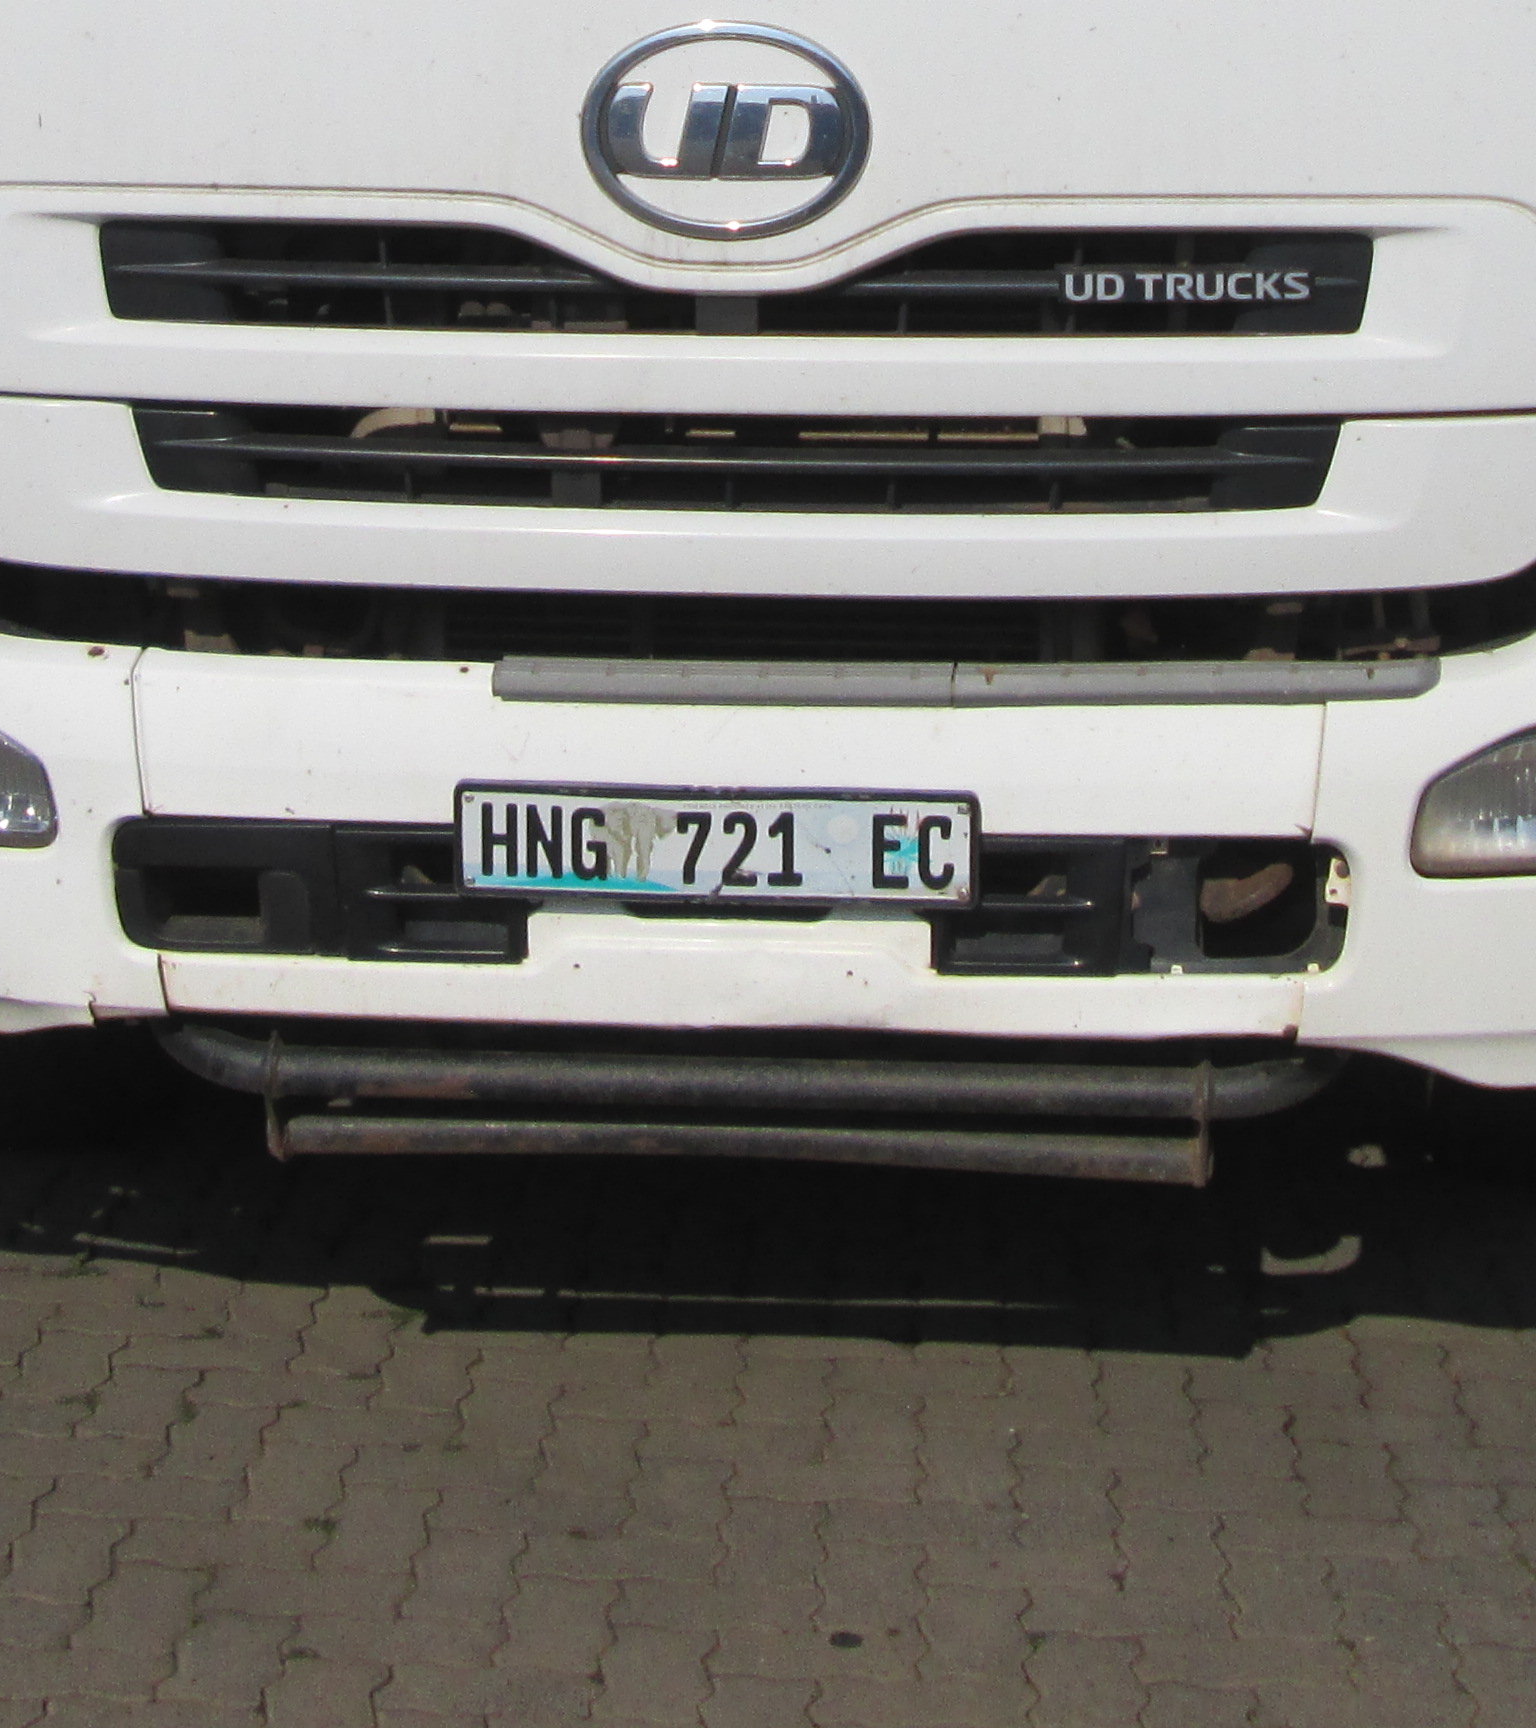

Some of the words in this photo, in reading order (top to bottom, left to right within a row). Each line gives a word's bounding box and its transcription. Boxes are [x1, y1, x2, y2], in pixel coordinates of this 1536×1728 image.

[607, 82, 845, 181] UD
[1065, 272, 1125, 302] UD
[1135, 271, 1311, 301] TRUCKS
[482, 801, 609, 881] HNG
[677, 811, 804, 888] 721
[871, 813, 956, 891] EC
